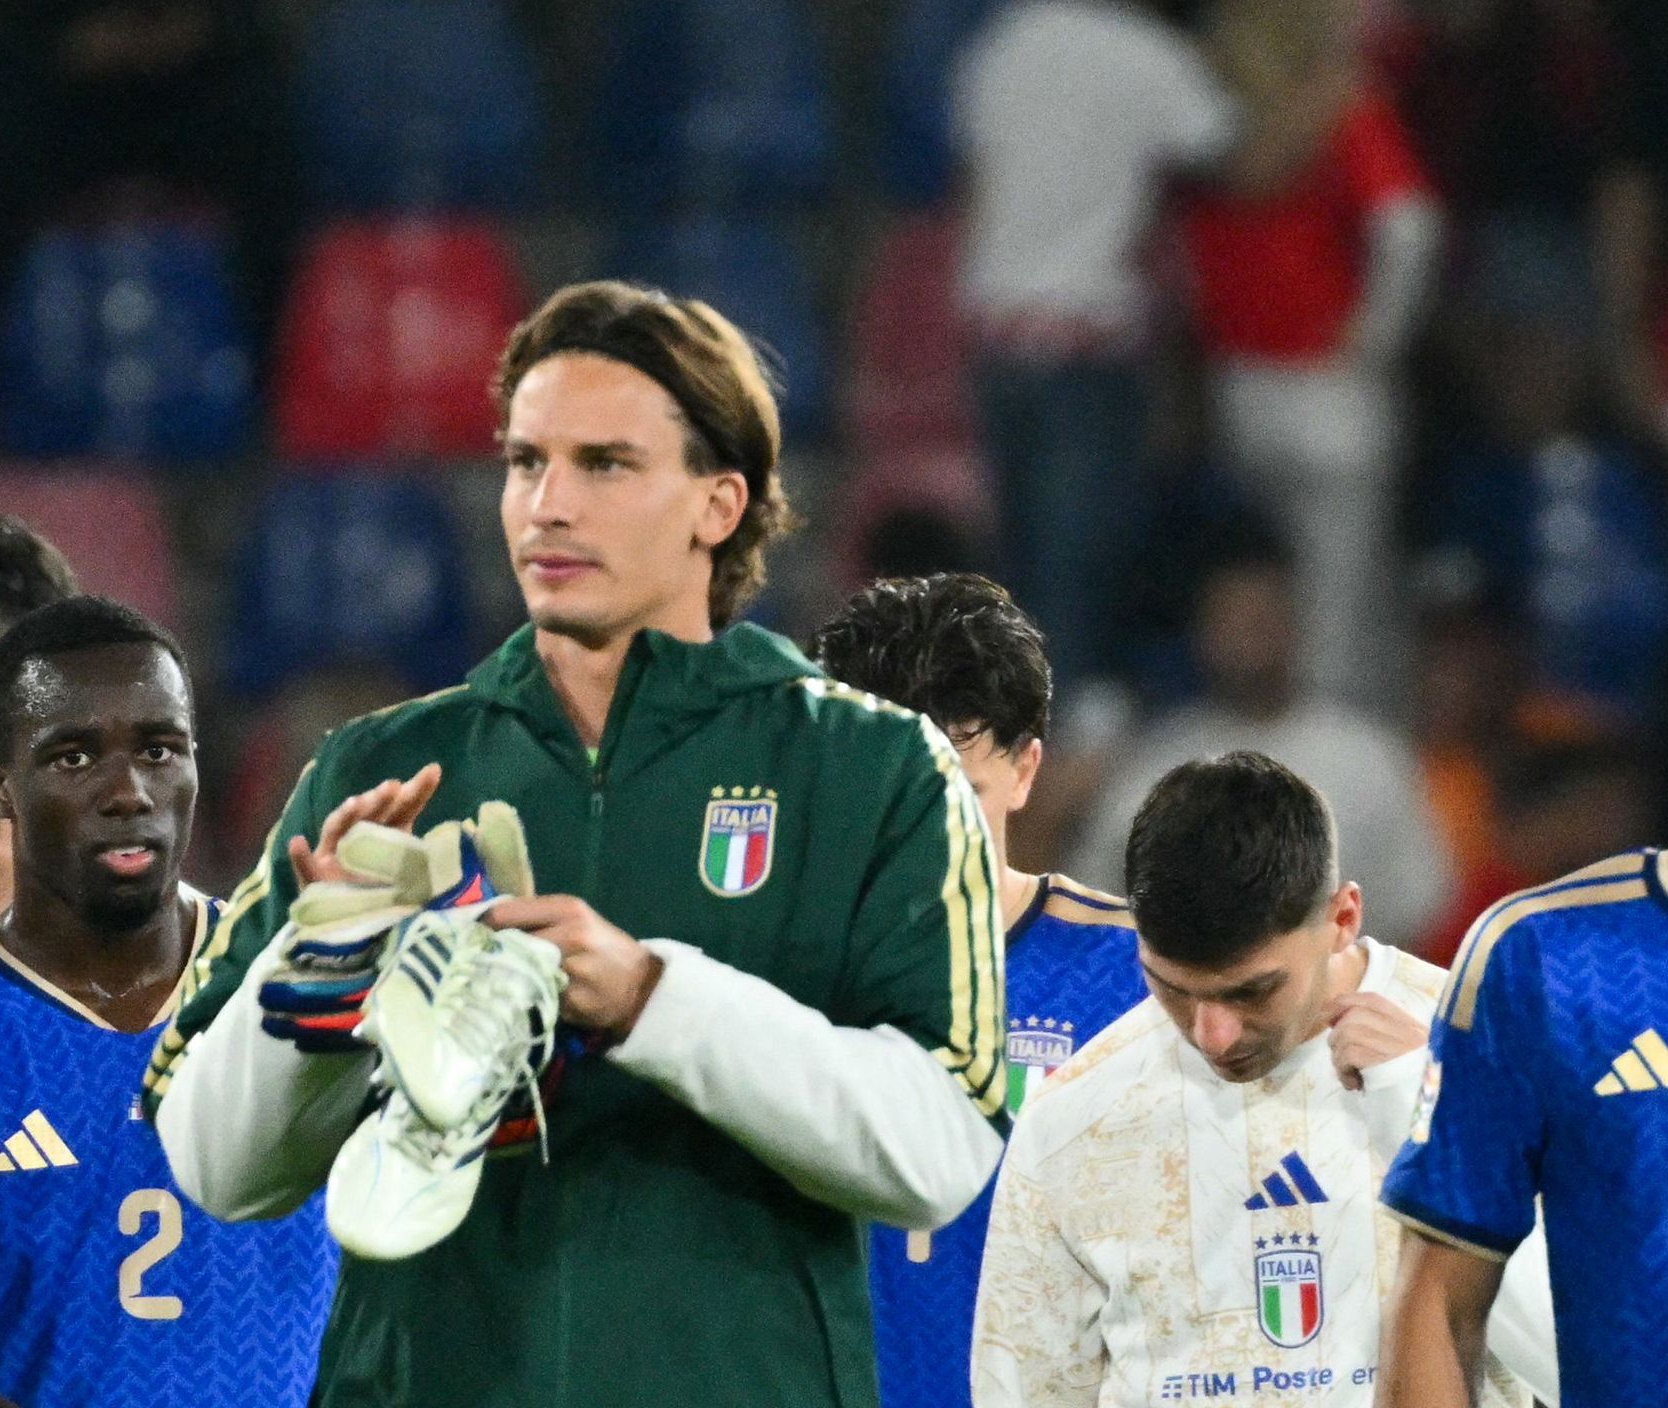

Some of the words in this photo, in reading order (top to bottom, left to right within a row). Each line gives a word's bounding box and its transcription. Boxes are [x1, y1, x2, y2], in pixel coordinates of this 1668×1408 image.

[712, 806, 769, 827] ITALIA
[1010, 1038, 1064, 1058] ITALIA
[118, 1188, 183, 1320] 2
[1260, 1259, 1317, 1277] ITALIA
[1187, 1372, 1236, 1397] TIM
[1252, 1366, 1333, 1392] Poste
